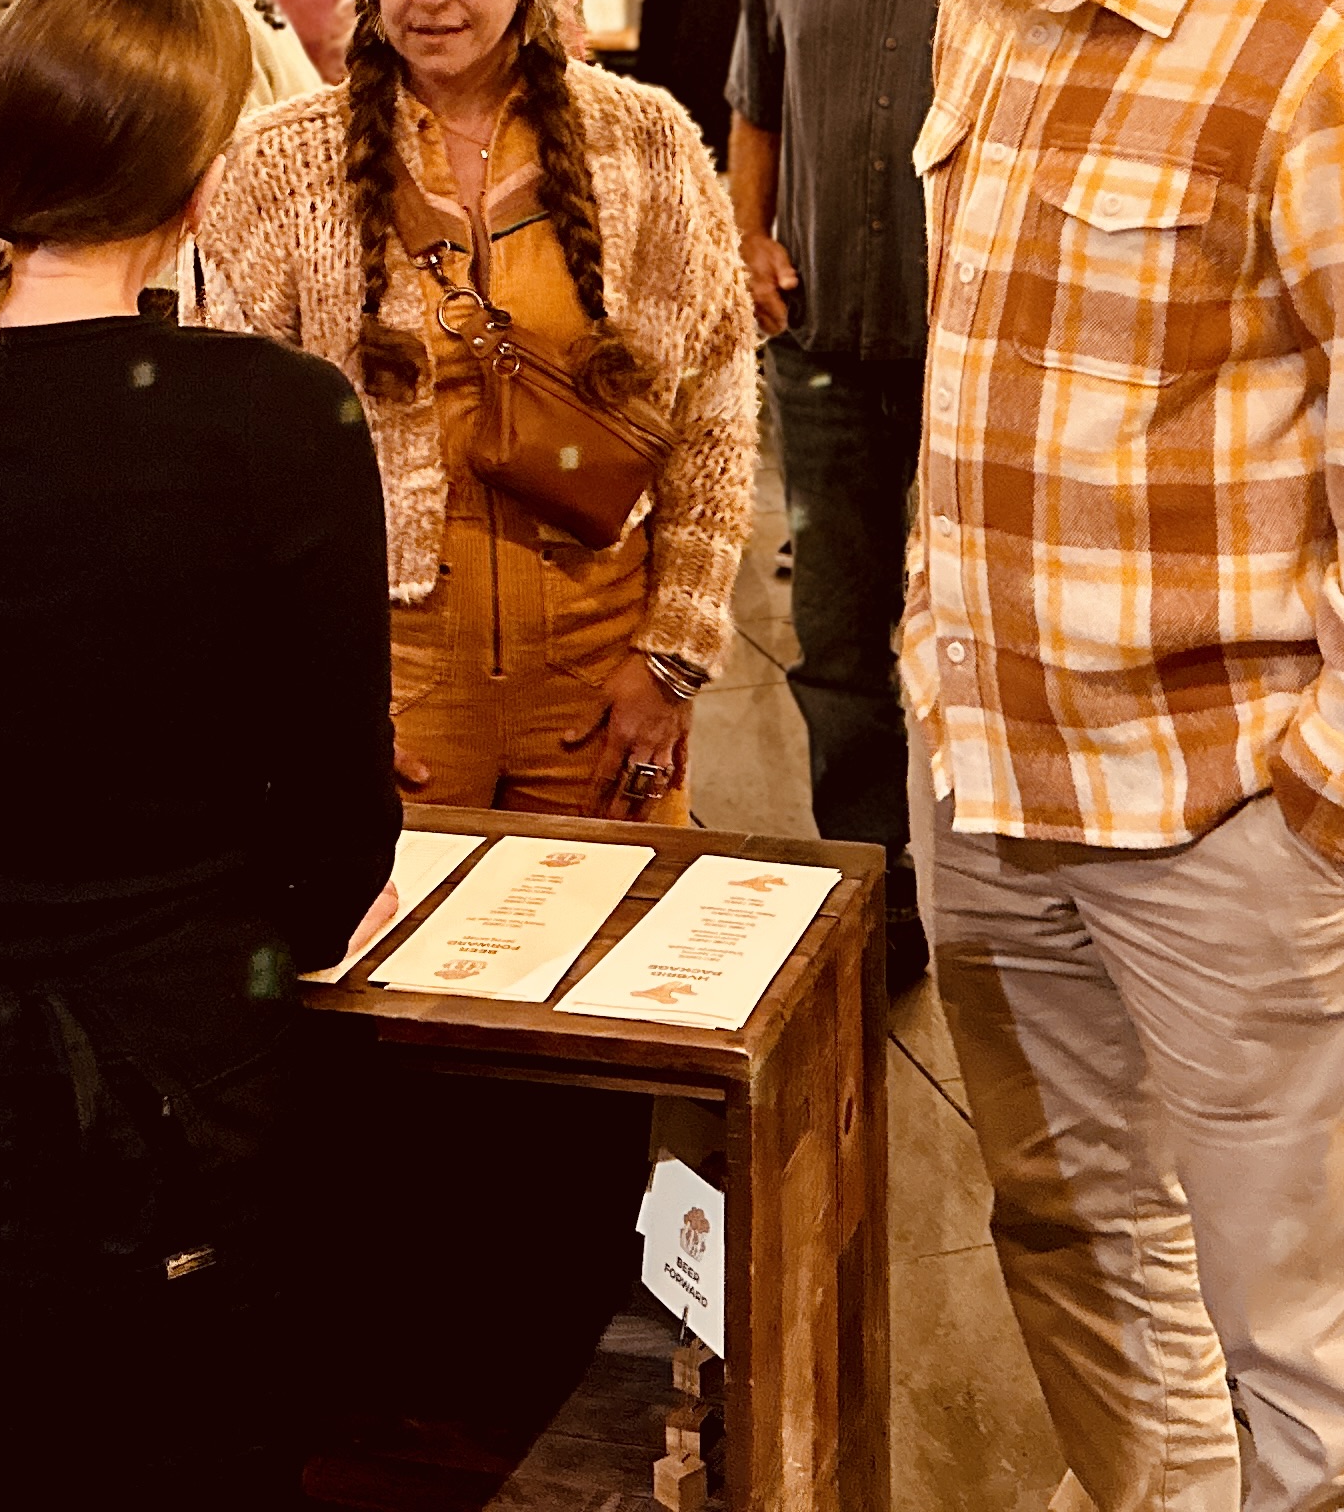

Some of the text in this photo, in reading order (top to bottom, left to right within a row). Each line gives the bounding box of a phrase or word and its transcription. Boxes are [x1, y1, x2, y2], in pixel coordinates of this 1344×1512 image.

[447, 941, 520, 951] FORWARD
[648, 965, 723, 976] PACKAGE
[651, 972, 710, 981] HYBRID
[677, 1256, 700, 1284] BEER
[664, 1262, 708, 1308] FORWARD
